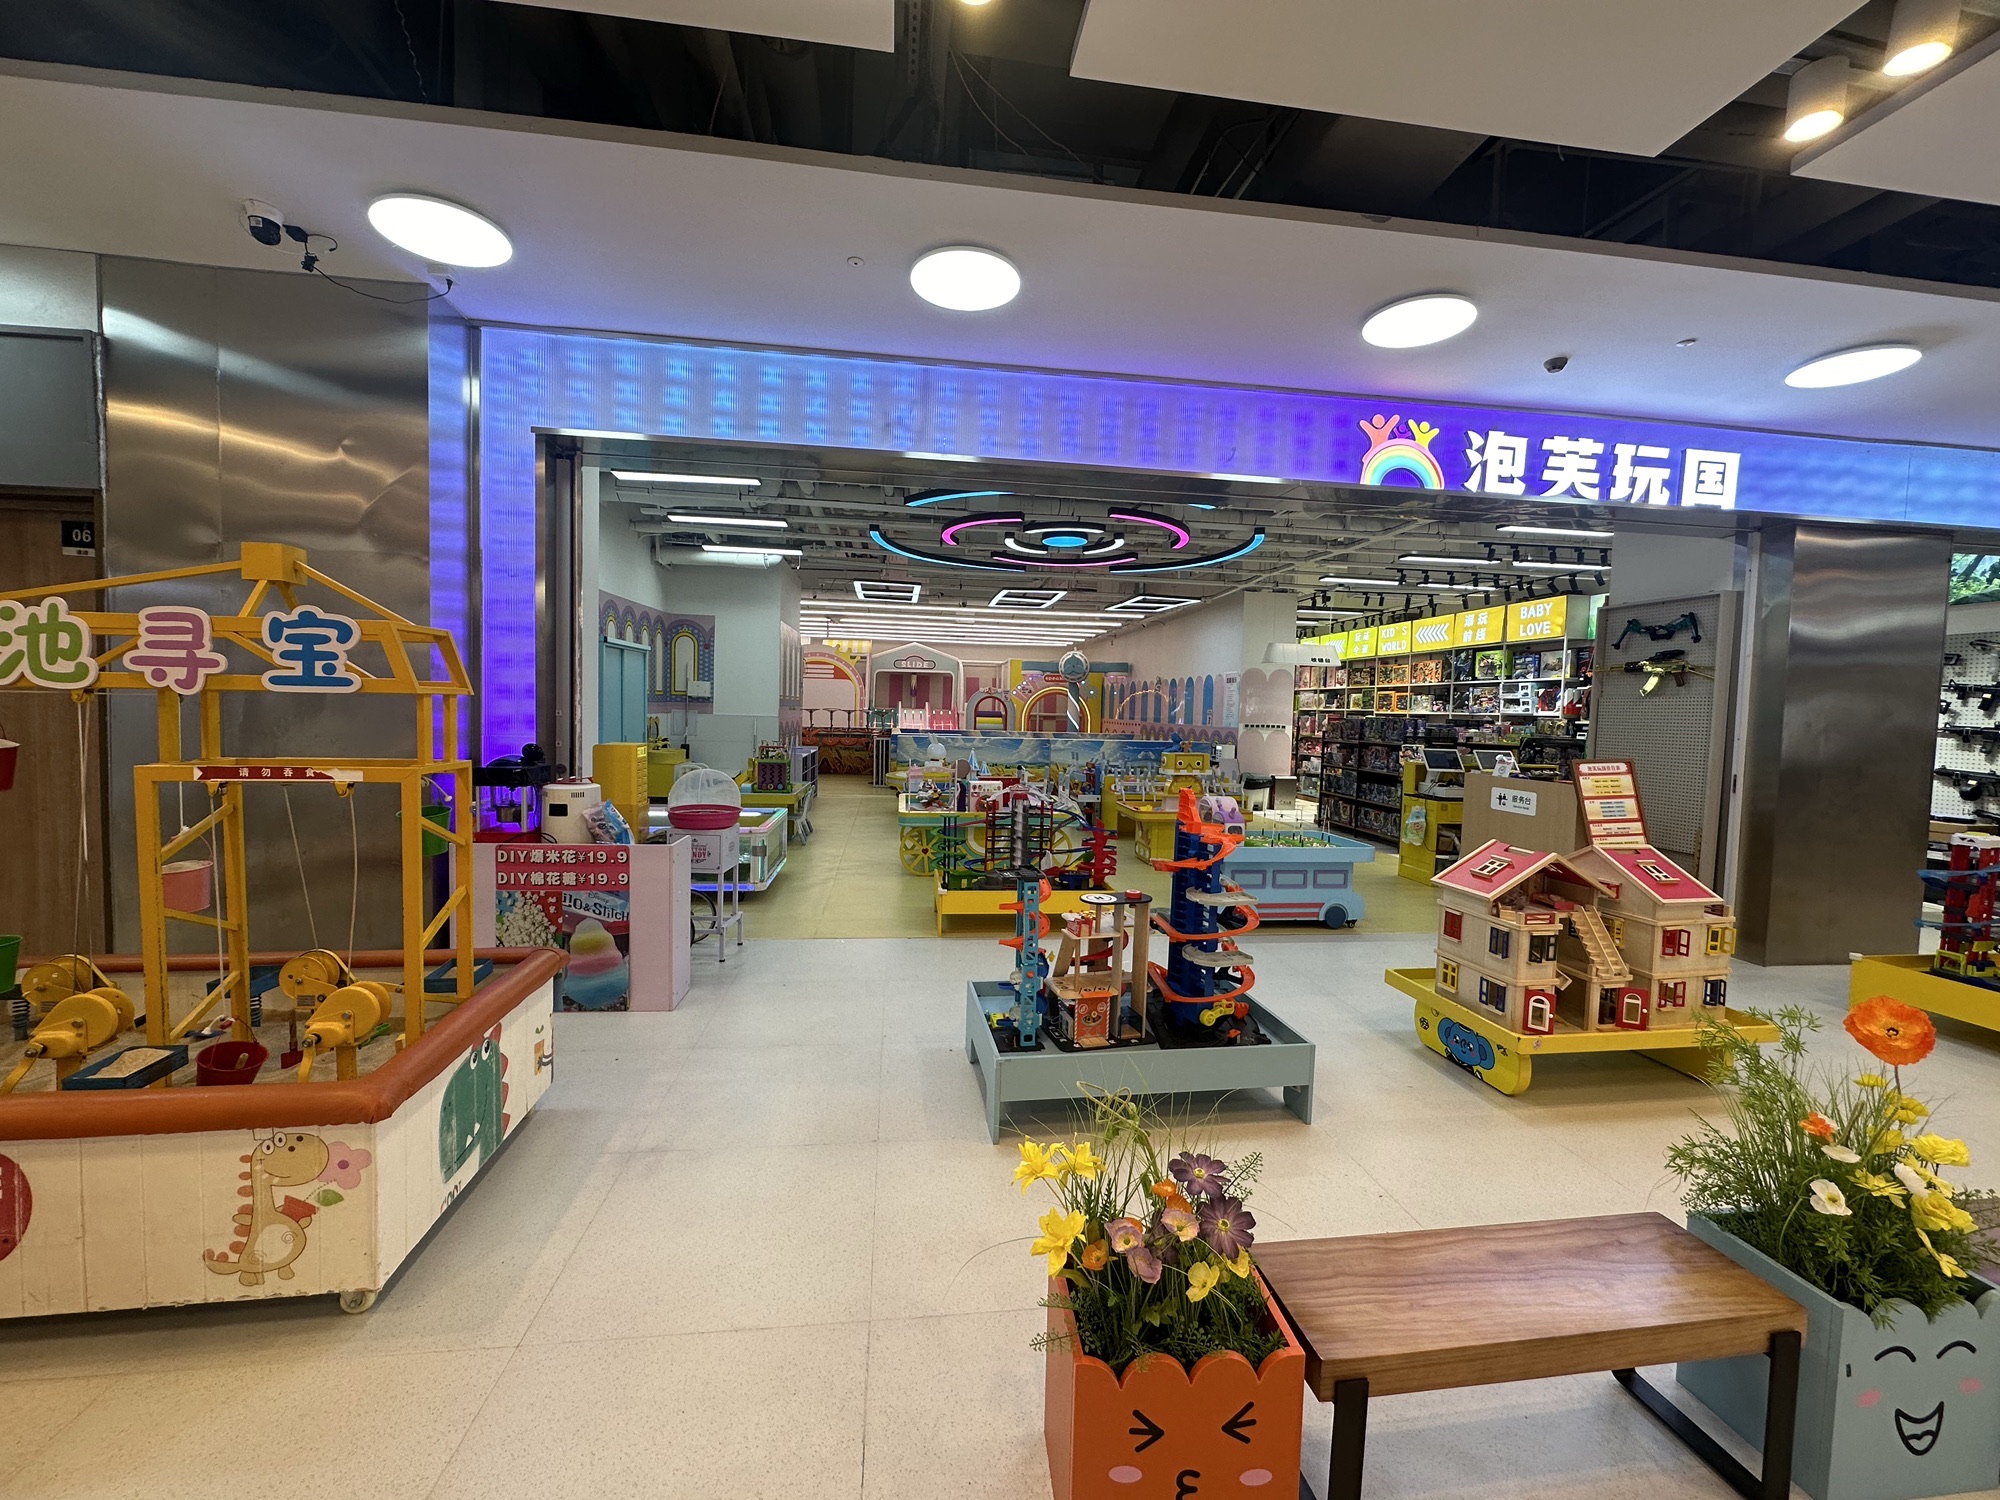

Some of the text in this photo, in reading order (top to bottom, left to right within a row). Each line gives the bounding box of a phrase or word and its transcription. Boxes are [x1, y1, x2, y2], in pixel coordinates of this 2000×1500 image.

[1464, 430, 1741, 509] 泡芙玩国
[72, 529, 92, 542] 06
[1519, 602, 1553, 620] BABY
[1519, 621, 1551, 637] LOVE
[0, 600, 355, 692] 池寻宝
[1381, 640, 1407, 652] WORLD
[901, 660, 929, 669] SLIDE
[239, 767, 315, 777] 请勿吞食
[1511, 795, 1531, 806] 服务台
